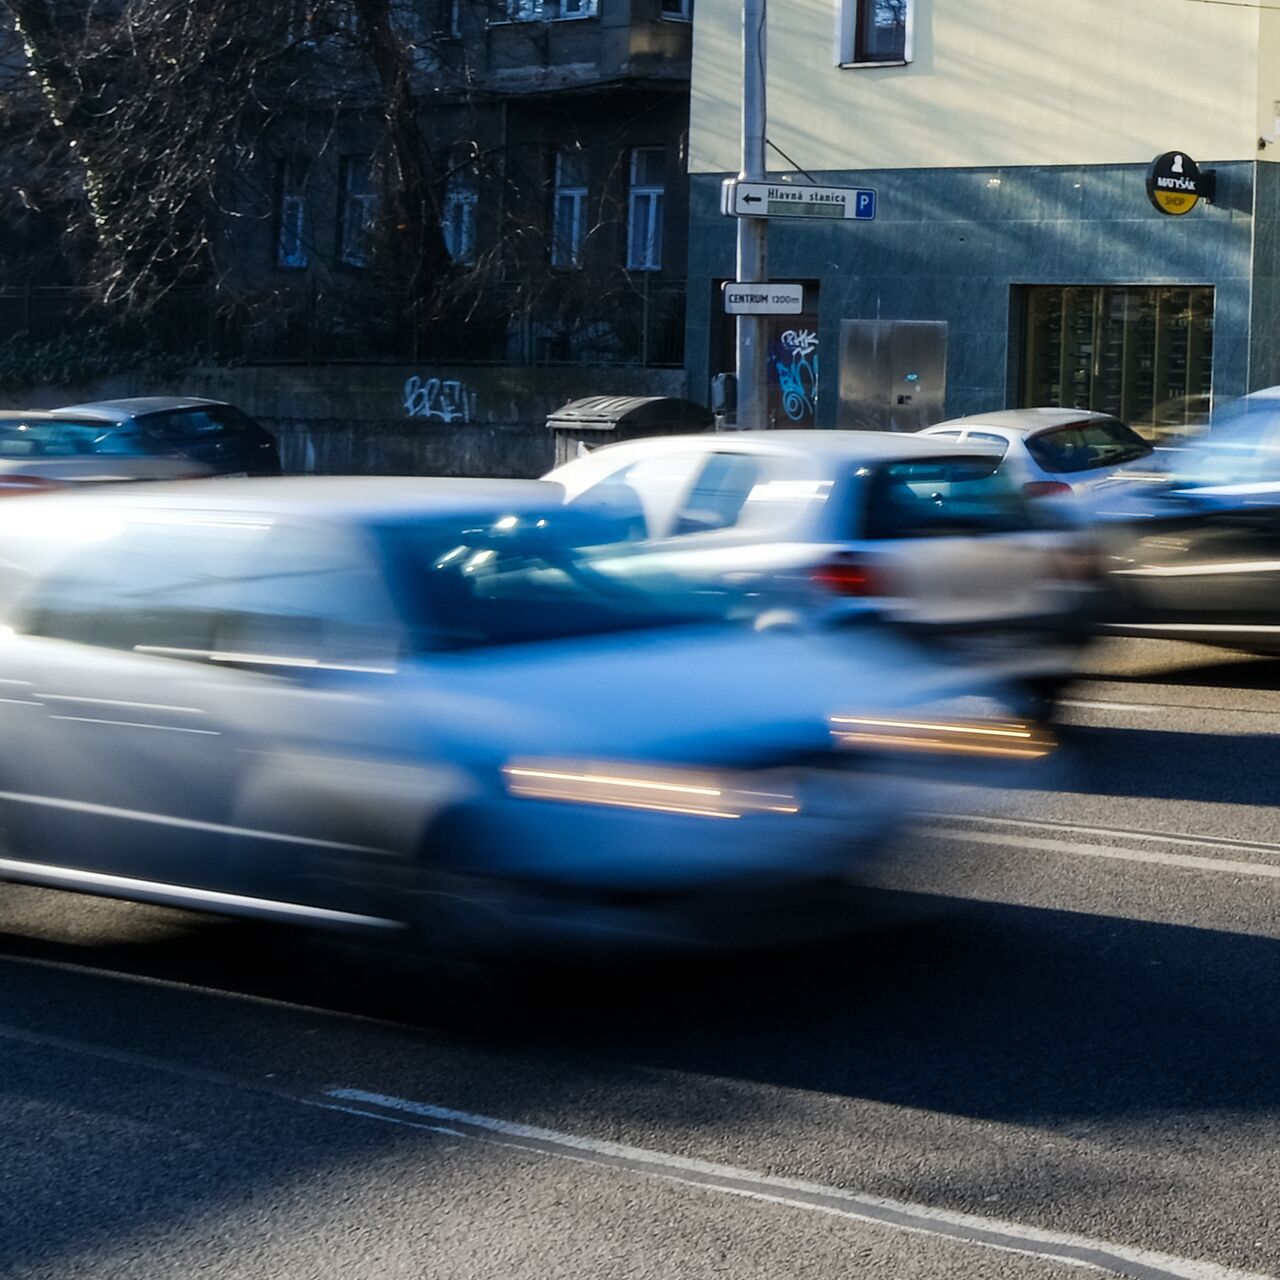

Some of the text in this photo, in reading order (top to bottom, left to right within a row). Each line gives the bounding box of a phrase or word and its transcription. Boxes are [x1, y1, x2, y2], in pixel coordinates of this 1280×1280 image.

[767, 188, 846, 203] Hlavná stanica
[860, 195, 869, 210] P
[728, 294, 768, 304] CENTRUM
